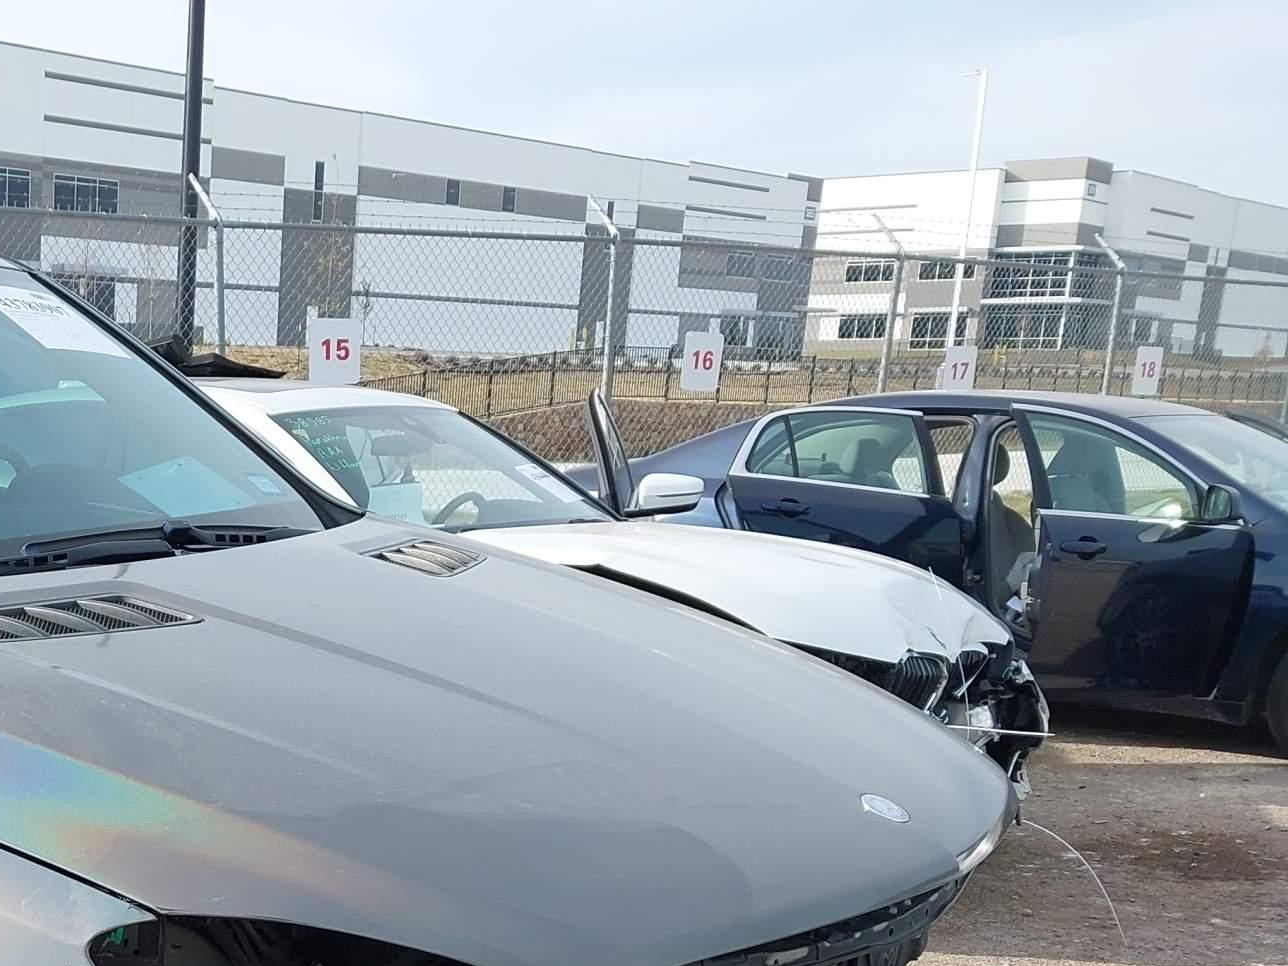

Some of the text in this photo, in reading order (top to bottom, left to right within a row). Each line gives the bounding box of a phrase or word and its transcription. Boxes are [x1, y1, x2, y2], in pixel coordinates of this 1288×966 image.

[321, 339, 350, 361] 15
[691, 351, 714, 371] 16
[1140, 362, 1156, 378] 18
[949, 362, 969, 379] 17
